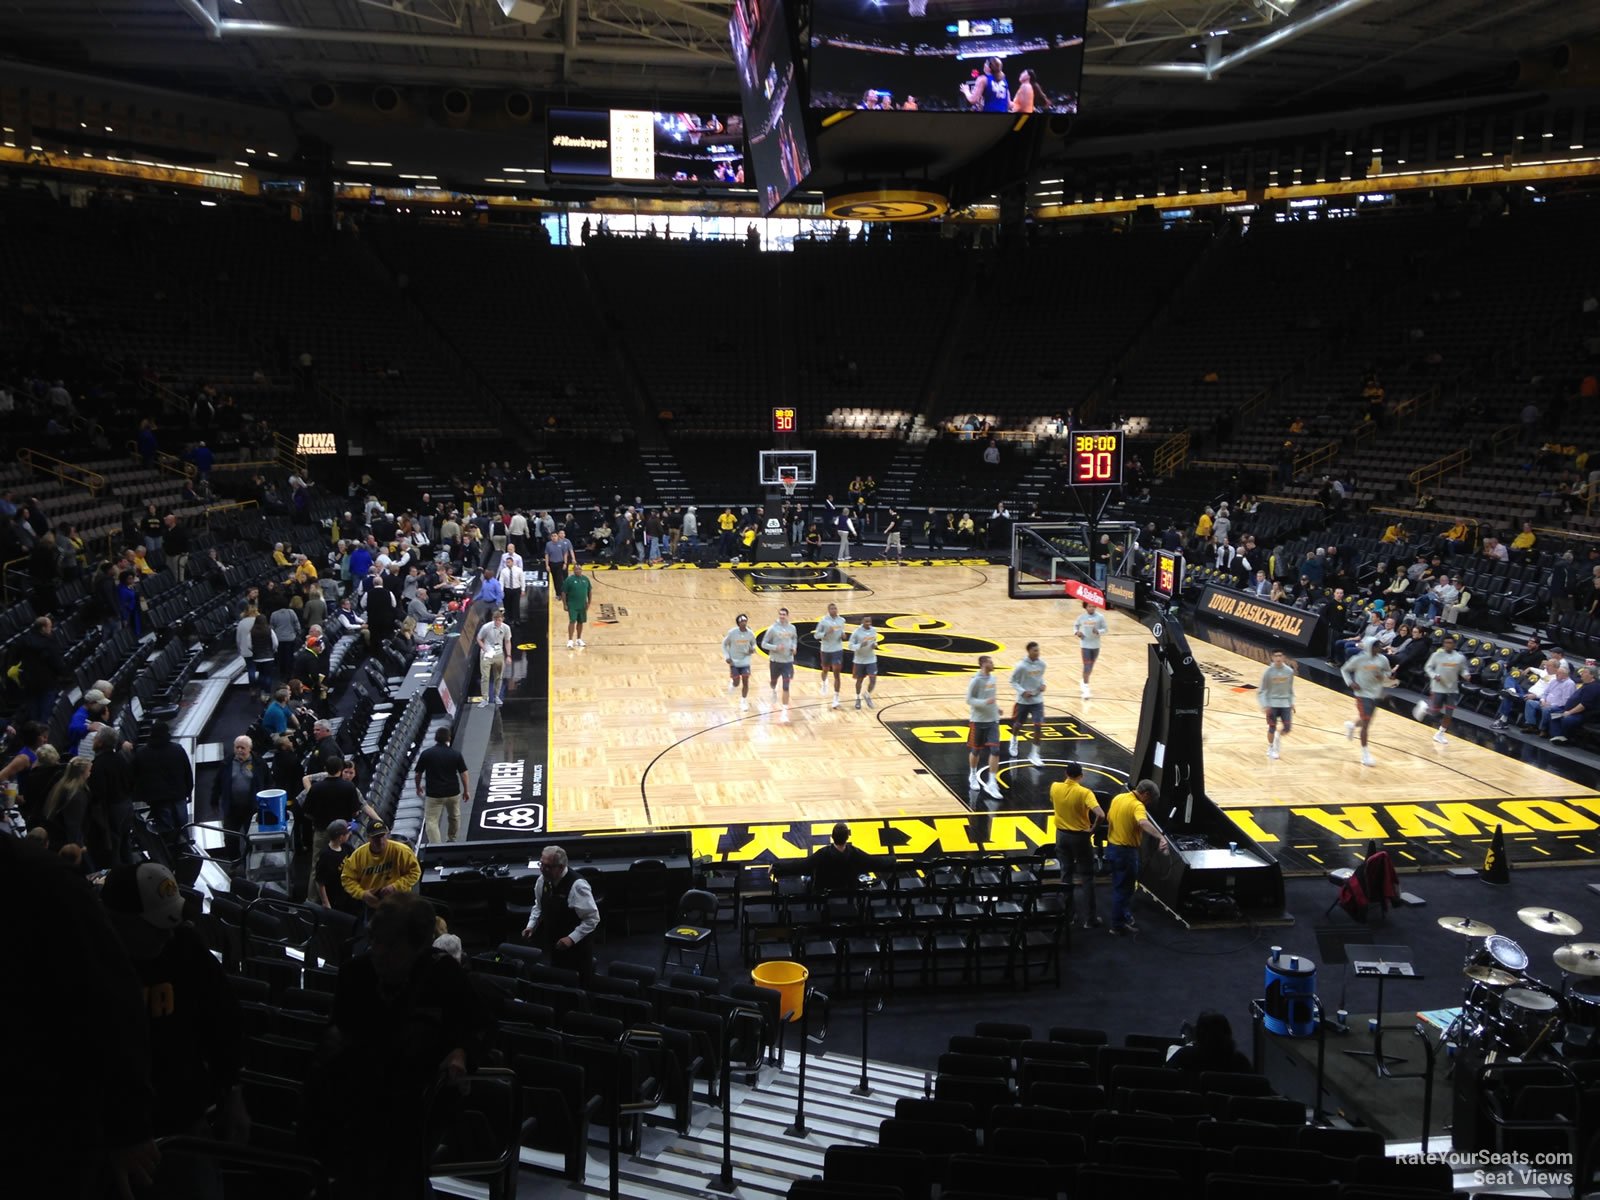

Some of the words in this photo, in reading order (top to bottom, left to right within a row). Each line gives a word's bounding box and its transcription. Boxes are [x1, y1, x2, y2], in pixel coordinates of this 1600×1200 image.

[552, 134, 608, 150] #Hawkeyes
[777, 416, 792, 429] 30
[297, 432, 336, 448] IOWA
[1076, 436, 1116, 452] 38:00
[1080, 452, 1111, 479] 30
[1208, 593, 1236, 615] IOWA
[1233, 601, 1304, 637] BASKETBALL
[486, 760, 525, 803] PIONEER
